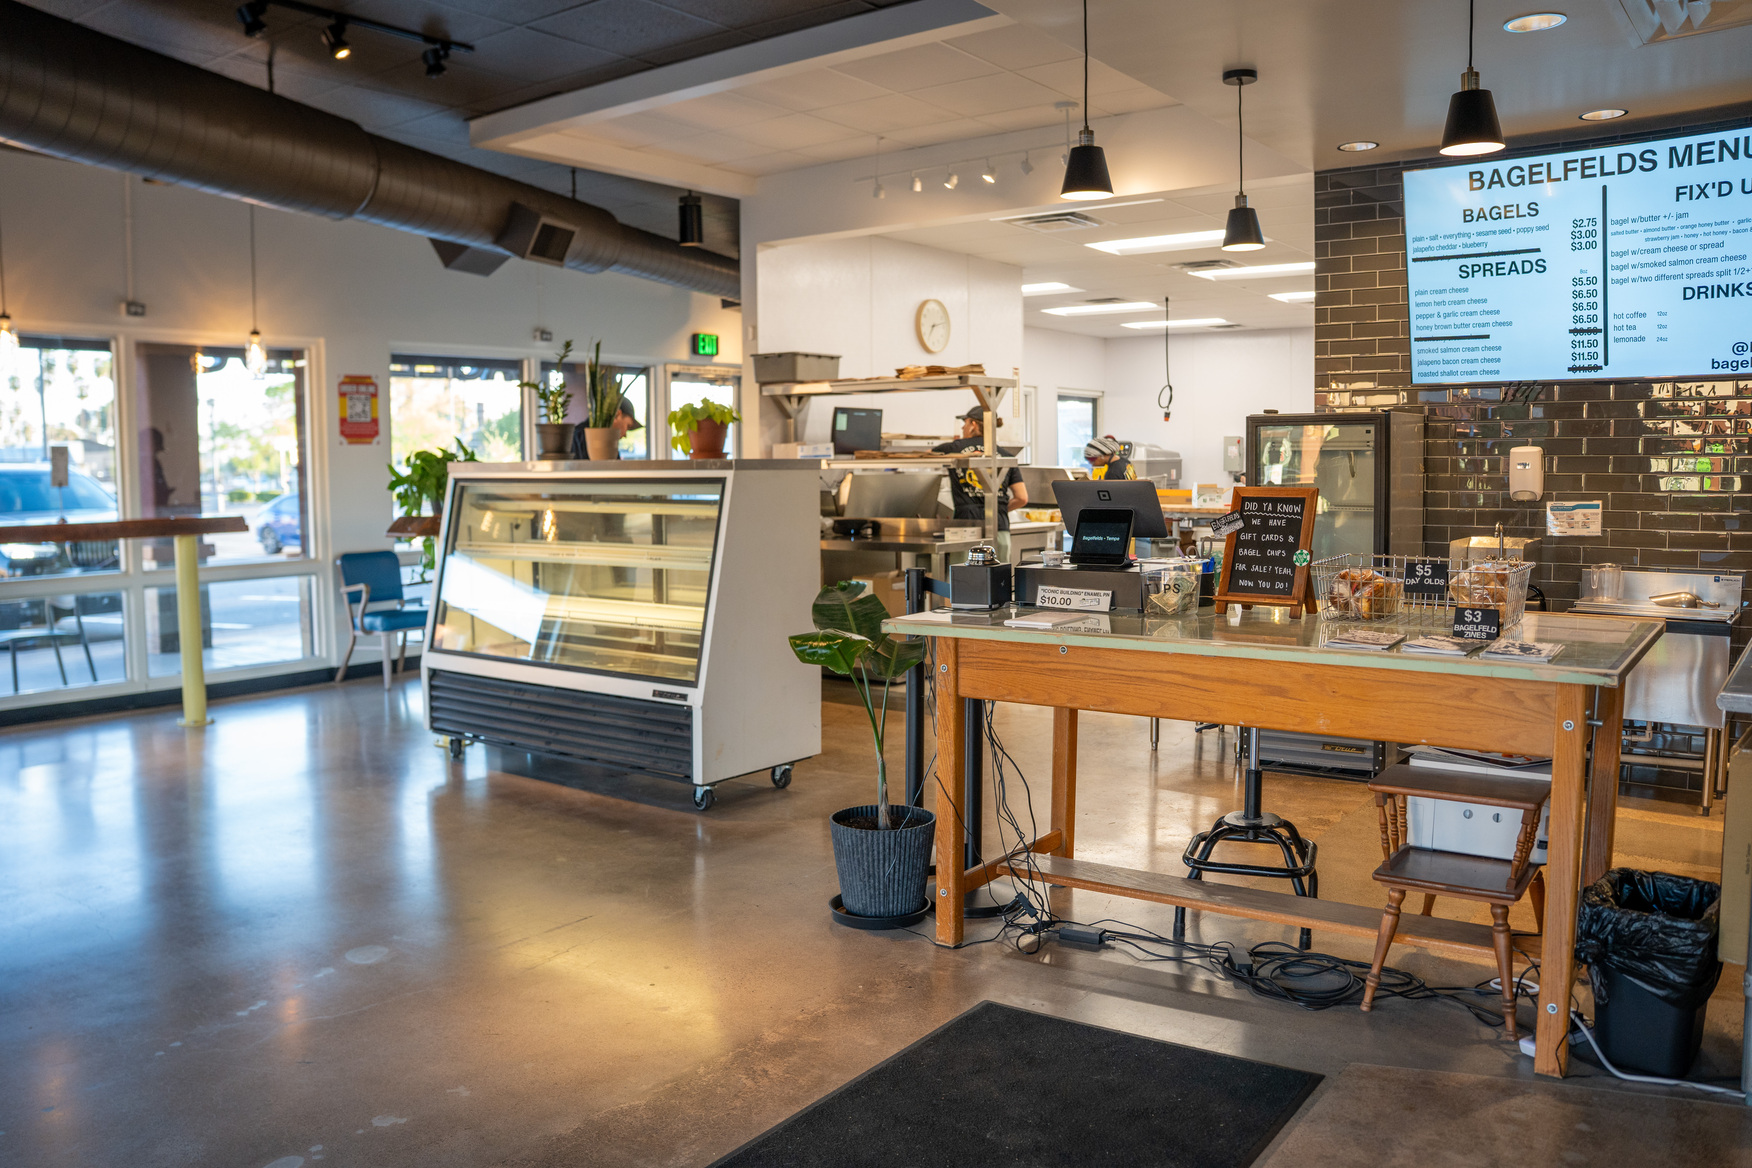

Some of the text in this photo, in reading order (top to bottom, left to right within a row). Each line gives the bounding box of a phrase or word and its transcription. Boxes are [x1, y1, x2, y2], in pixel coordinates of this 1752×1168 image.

[1469, 149, 1657, 191] BAGELFELDS
[1676, 181, 1733, 202] FIX'D
[1463, 202, 1539, 223] BAGELS
[1572, 218, 1597, 229] $2.75
[1610, 217, 1629, 226] bagel
[1630, 214, 1660, 223] w/butter
[1676, 212, 1689, 220] jam
[1443, 231, 1471, 241] everything
[1516, 226, 1534, 235] poppy
[1571, 229, 1597, 240] $3.00
[1462, 240, 1488, 249] blueberry
[1571, 240, 1597, 252] $3.00
[1610, 249, 1629, 258] bagel
[1630, 248, 1661, 256] w/cream
[1663, 244, 1688, 253] cheese
[1699, 240, 1725, 251] spread
[1610, 263, 1629, 272] bagel
[1630, 260, 1666, 270] w/smoked
[1720, 253, 1747, 262] cheese
[1458, 259, 1547, 279] SPREADS
[1572, 276, 1597, 287] $5.50
[1610, 276, 1629, 286] bagel
[1654, 272, 1684, 282] different
[1685, 268, 1714, 280] spreads
[1716, 269, 1731, 278] split
[1572, 289, 1598, 300] $6.50
[1683, 282, 1752, 300] DRINKS
[1572, 301, 1598, 312] $6.50
[1415, 312, 1435, 320] pepper
[1442, 310, 1459, 319] garlic
[1572, 314, 1598, 325] $6.50
[1626, 311, 1646, 319] coffee
[1416, 324, 1433, 332] honey
[1434, 322, 1452, 330] brown
[1453, 321, 1471, 329] butter
[1492, 319, 1513, 327] cheese
[698, 334, 716, 355] EXIT
[1571, 339, 1598, 349] $11.50
[1613, 335, 1646, 343] lemonade
[1572, 351, 1598, 361] $11.50
[1244, 502, 1301, 513] DID YA KNOW
[1261, 534, 1284, 542] CARDS
[1239, 548, 1286, 557] BAGEL CHIPS
[1235, 563, 1293, 576] FOR SALE? YEAH,
[1416, 564, 1432, 576] $5
[1258, 580, 1270, 588] YOU
[1275, 582, 1288, 591] DO!
[1405, 577, 1420, 585] DAY
[1040, 595, 1072, 606] $10.00
[1464, 609, 1482, 622] $3
[1454, 624, 1497, 633] BAGELFELD
